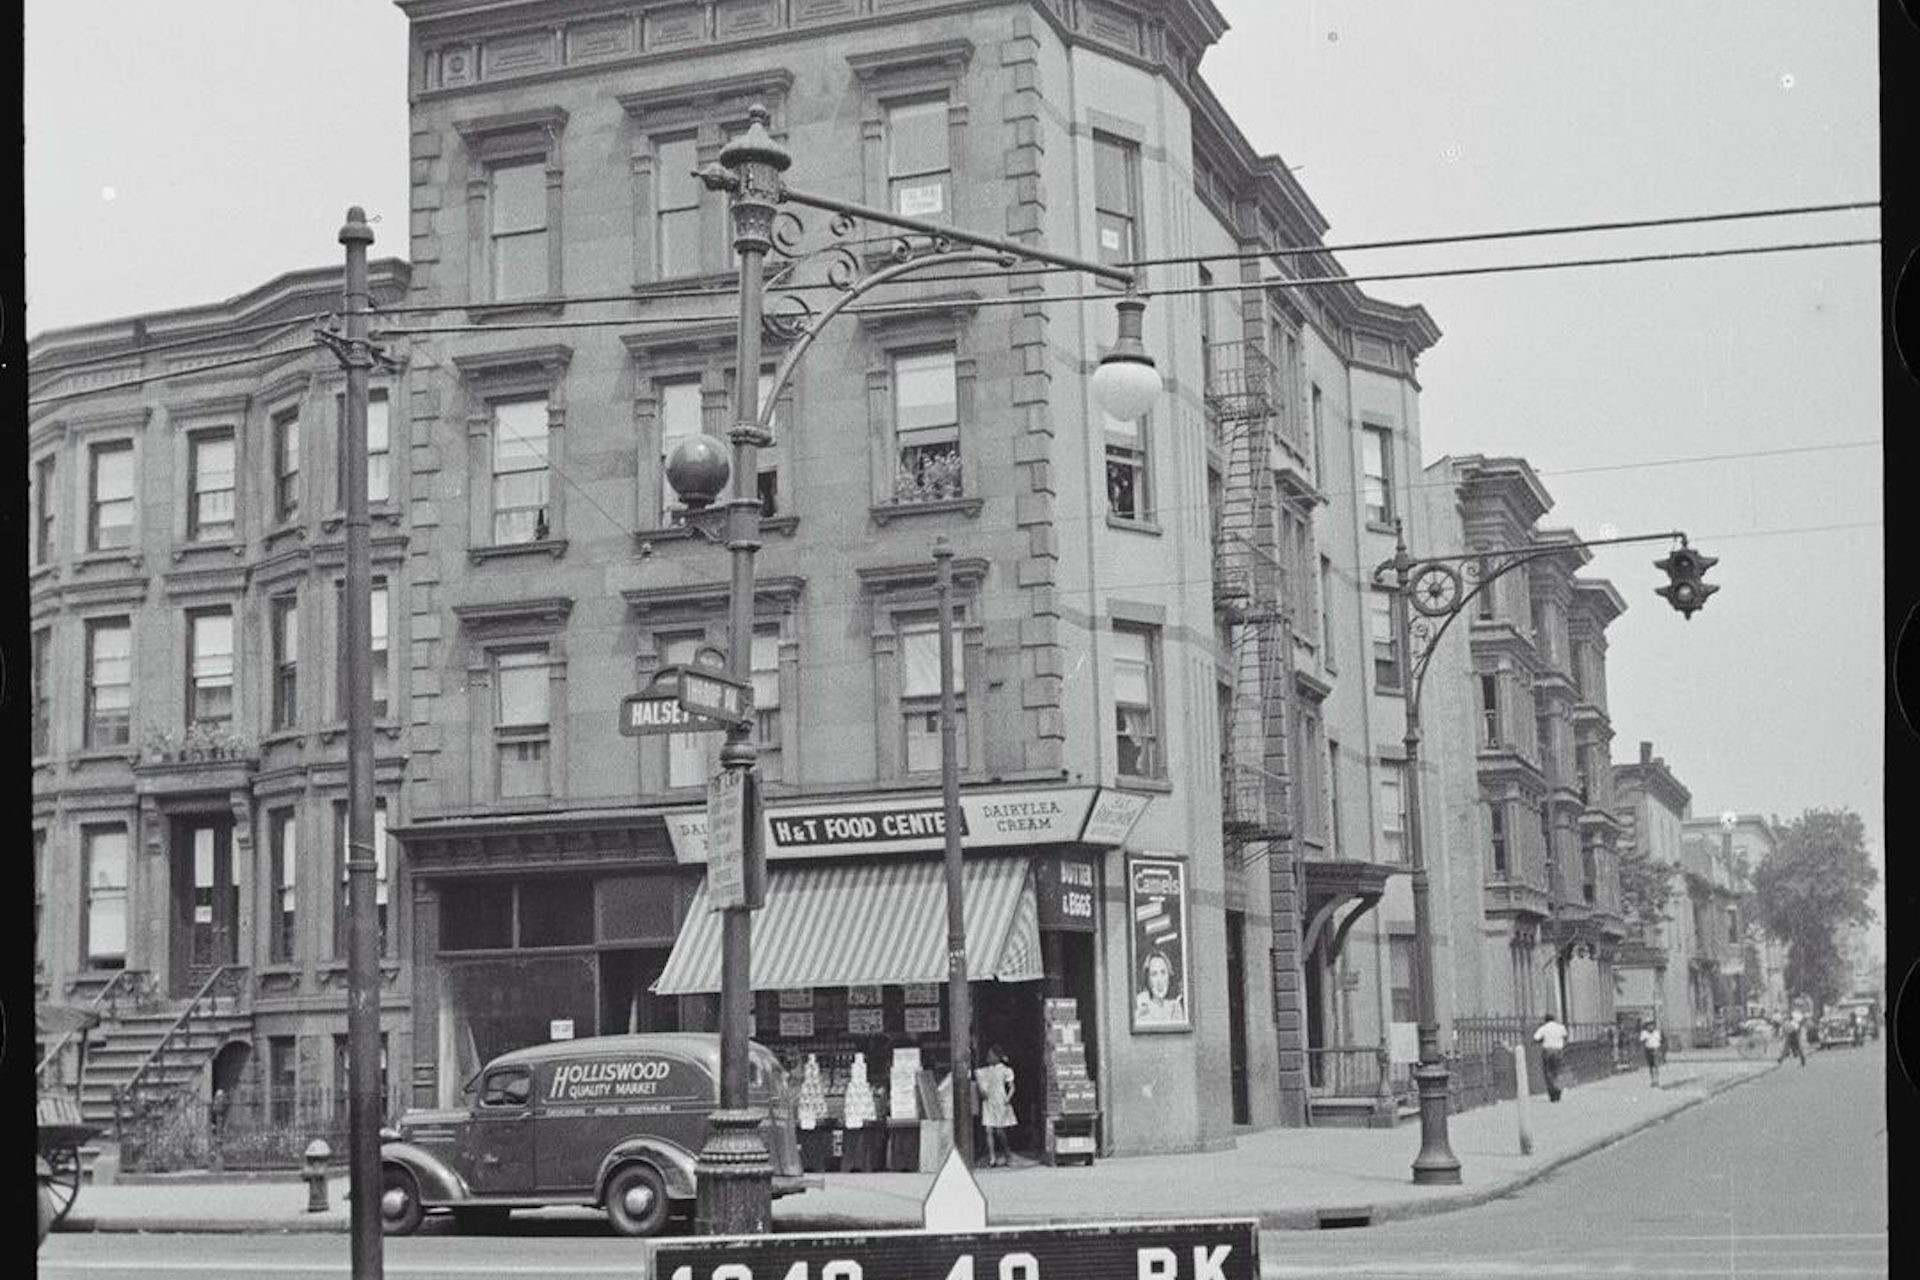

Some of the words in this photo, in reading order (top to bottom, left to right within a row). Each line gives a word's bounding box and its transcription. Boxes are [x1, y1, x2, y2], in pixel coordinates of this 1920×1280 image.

[982, 802, 1063, 818] DAIRYLEA
[776, 820, 817, 842] H&T
[824, 817, 878, 840] FOOD
[882, 812, 963, 836] CENTE
[996, 818, 1052, 832] CREAM
[1136, 868, 1180, 895] Camels
[551, 1062, 670, 1098] HOLLISWOOD
[569, 1083, 611, 1098] QUALITY
[615, 1082, 657, 1095] MARKET
